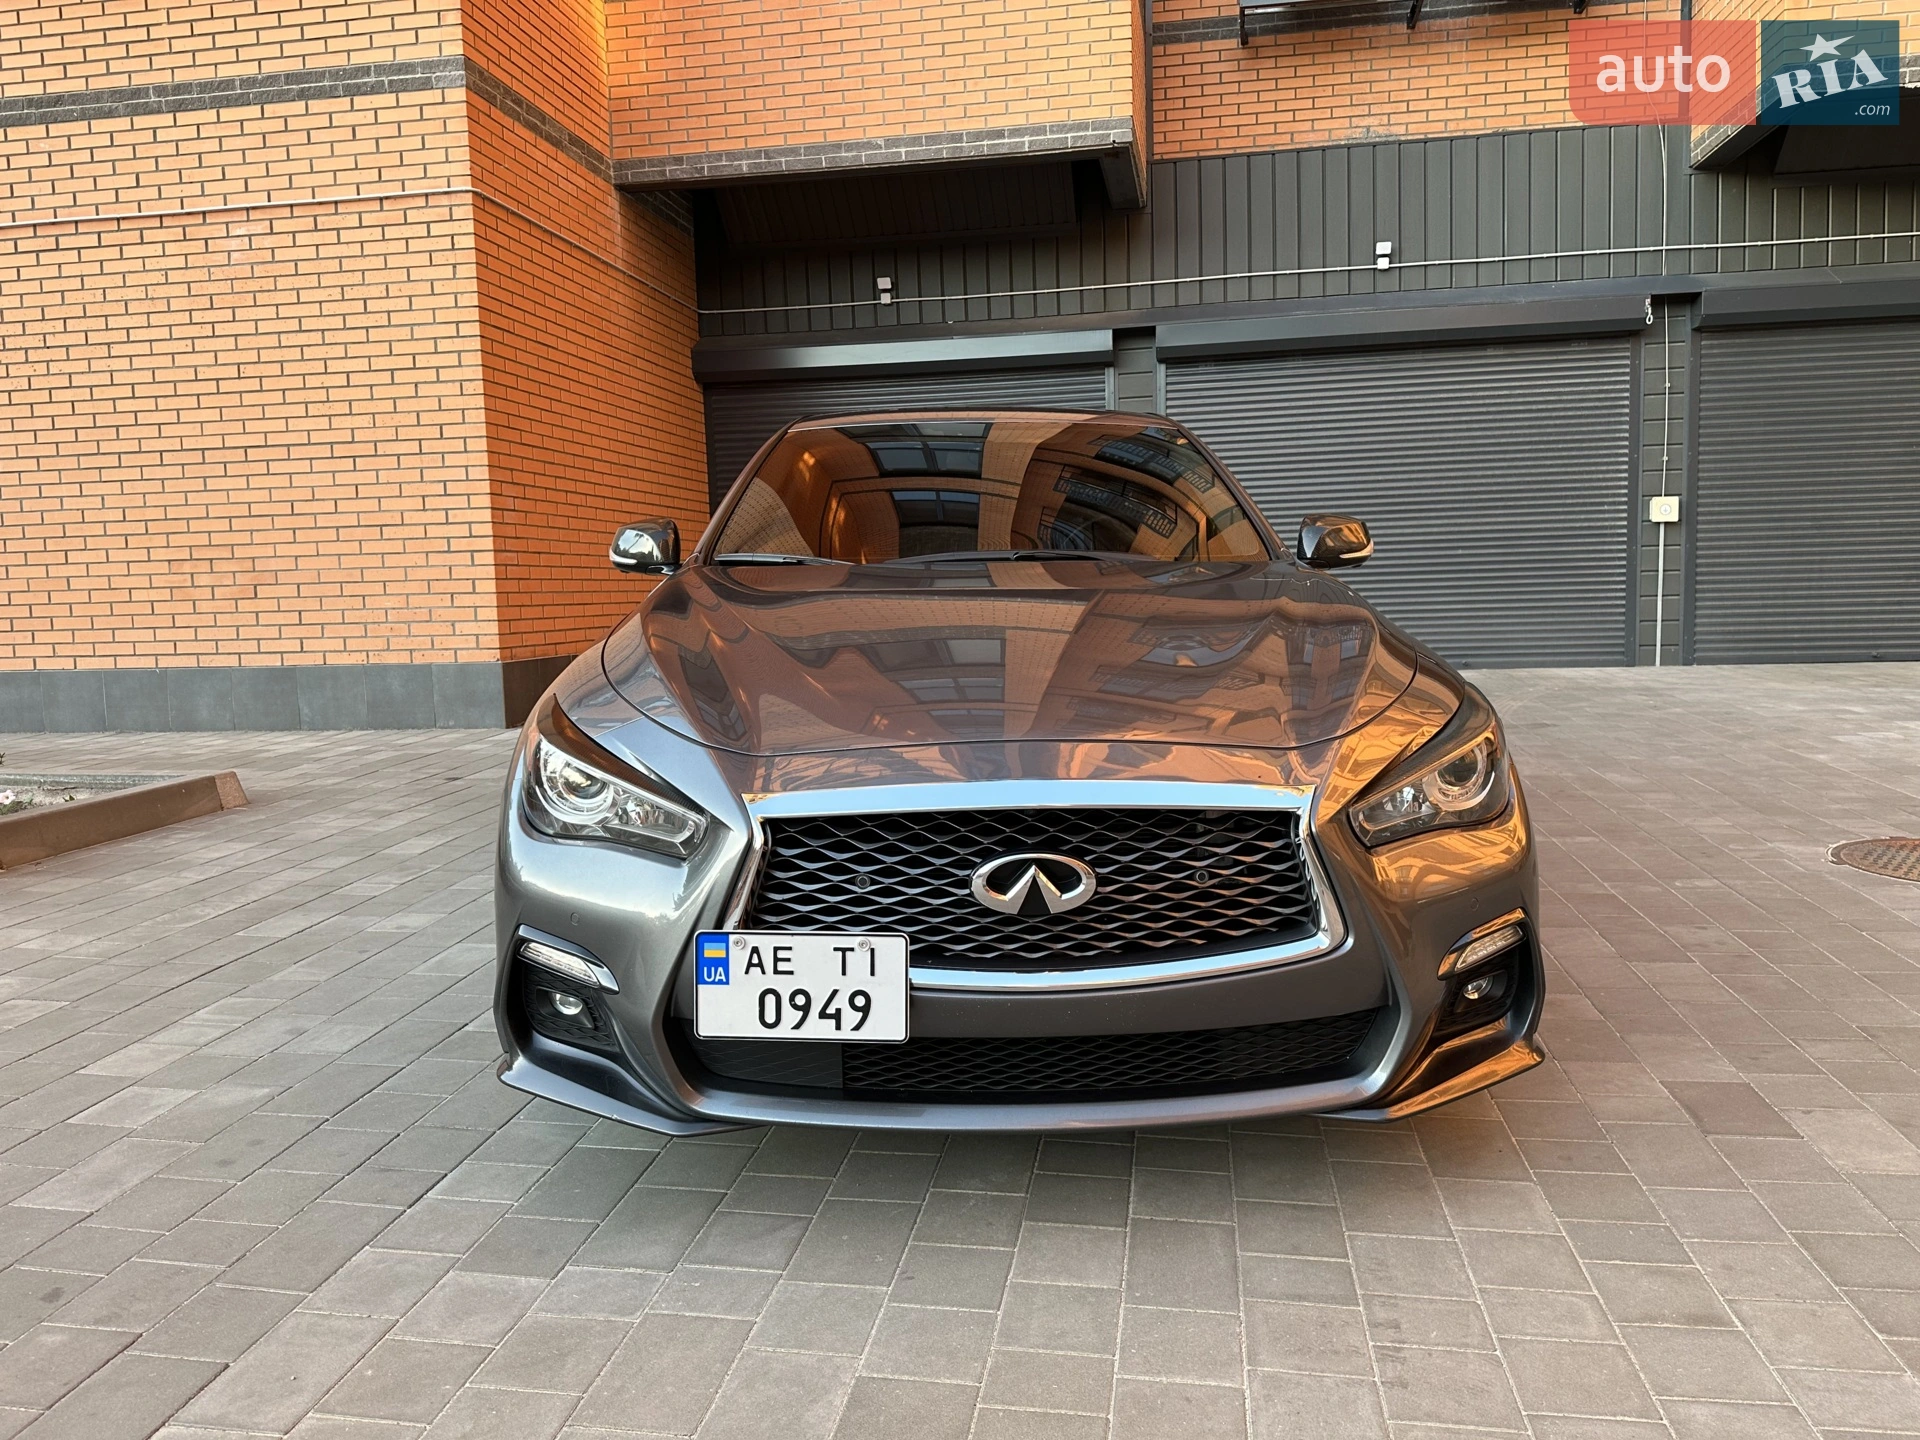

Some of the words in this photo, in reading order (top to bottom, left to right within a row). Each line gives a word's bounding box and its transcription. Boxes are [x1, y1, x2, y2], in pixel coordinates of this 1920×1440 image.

[703, 966, 727, 982] UA
[744, 946, 795, 975] AE
[833, 946, 876, 977] TI
[758, 988, 872, 1031] 0949
